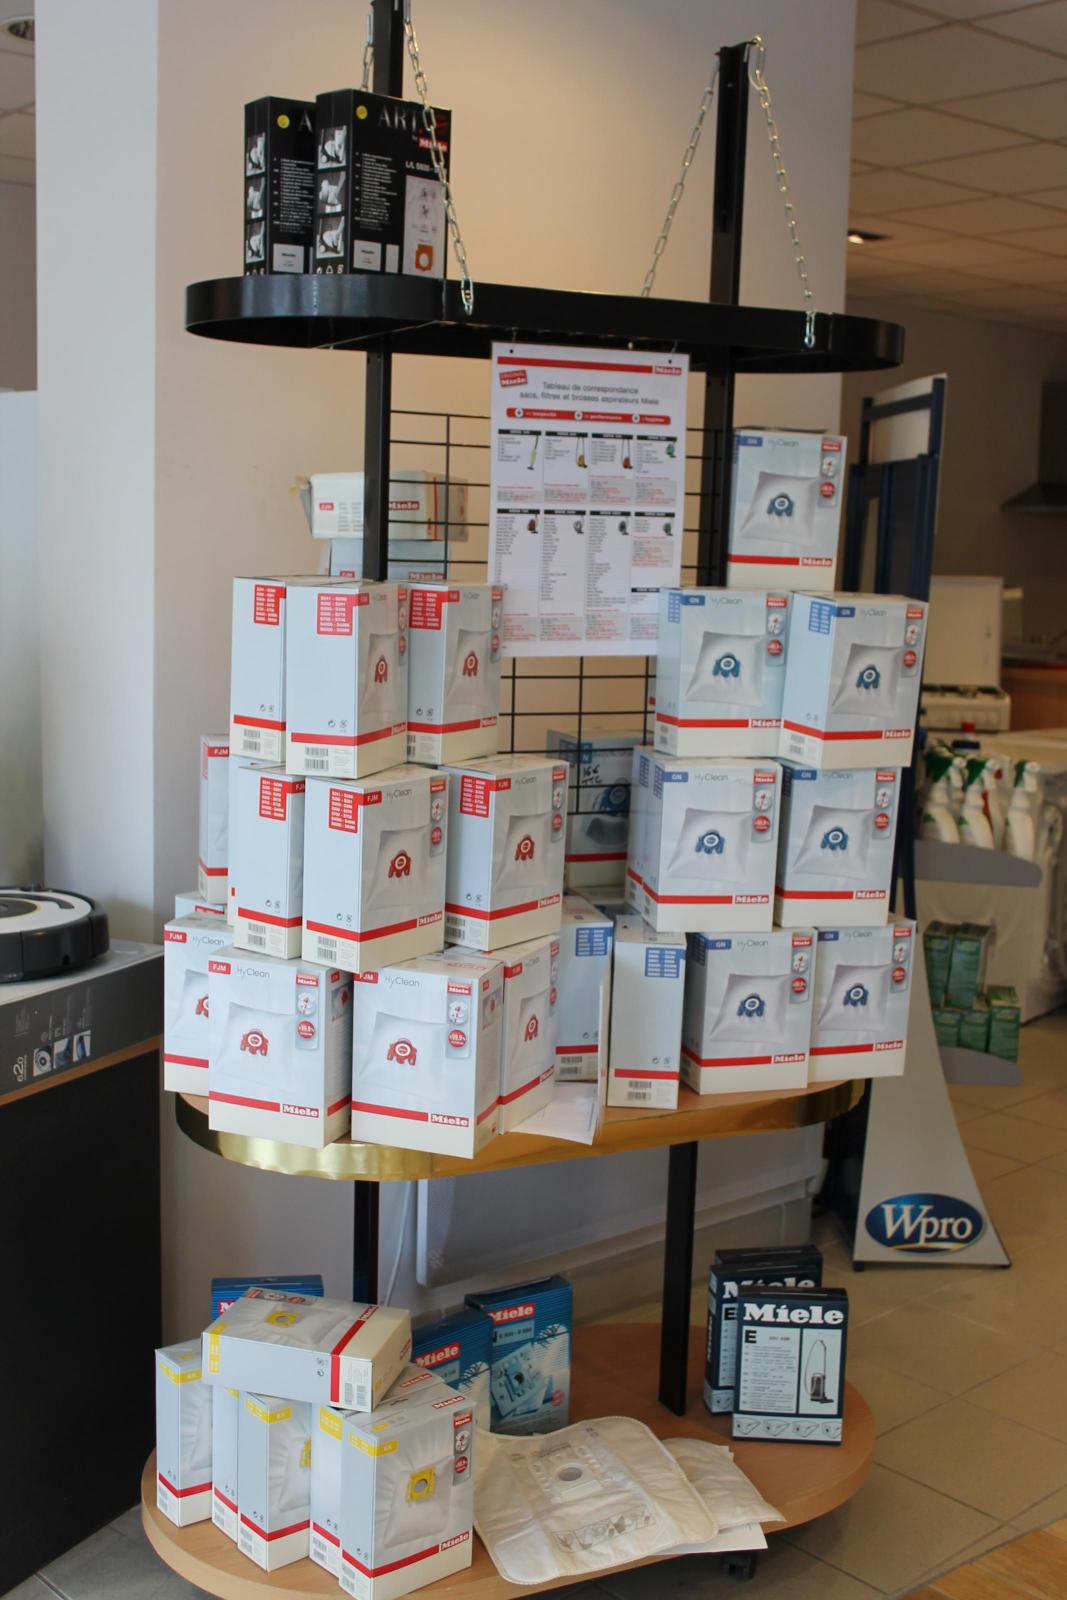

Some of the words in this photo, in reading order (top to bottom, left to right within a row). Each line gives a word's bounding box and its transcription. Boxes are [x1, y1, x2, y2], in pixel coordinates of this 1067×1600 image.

[543, 381, 570, 391] Tableau
[572, 384, 581, 392] de
[583, 385, 638, 395] correspondance
[801, 558, 833, 567] Miele
[752, 719, 782, 728] Miele
[884, 729, 912, 738] Miele
[736, 895, 769, 904] Miele
[856, 890, 886, 899] Miele
[418, 911, 443, 927] Miele
[212, 964, 227, 973] FJM
[237, 967, 270, 984] HyClean
[384, 975, 420, 989] HyClean
[875, 1040, 903, 1051] Miele
[774, 1053, 805, 1064] Miele
[283, 1104, 319, 1117] Miele
[431, 1113, 469, 1127] Miele
[880, 1203, 973, 1247] Wpro
[488, 1304, 534, 1321] Miele
[724, 1307, 736, 1321] E
[743, 1303, 844, 1324] Miele
[744, 1329, 757, 1344] E
[416, 1345, 459, 1368] Miele
[432, 1396, 465, 1409] Miele
[441, 1532, 470, 1551] Miele
